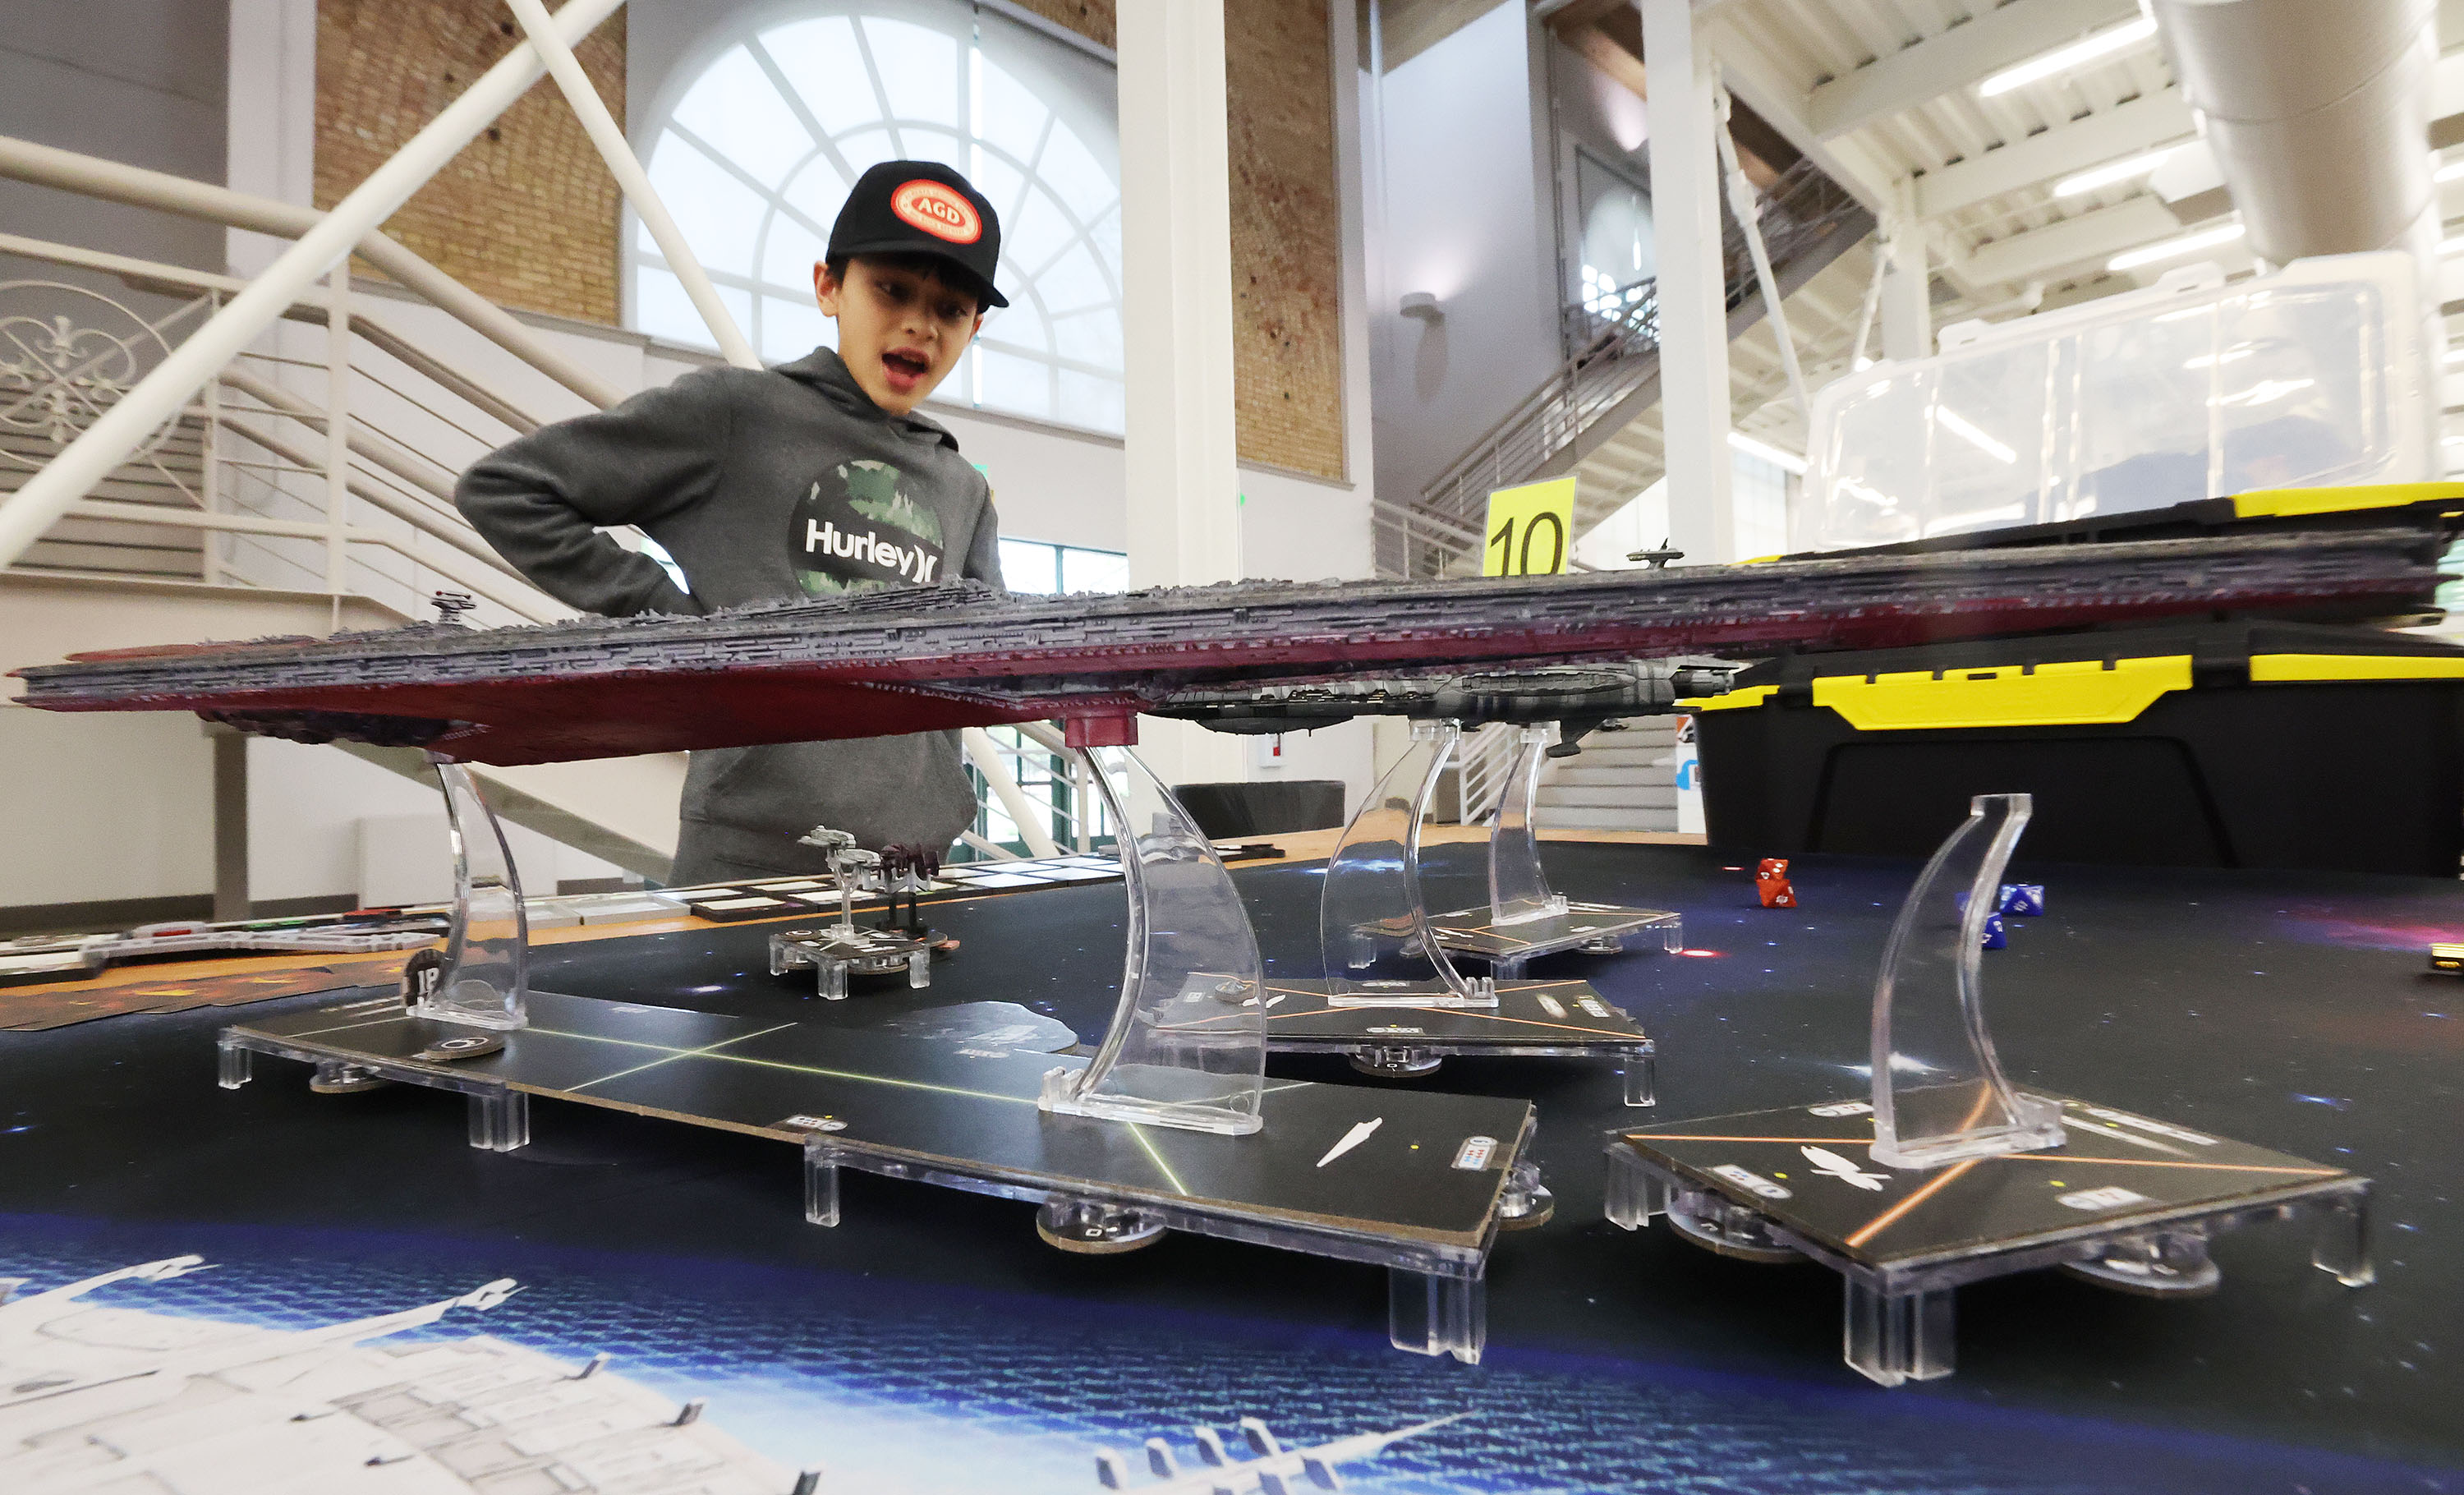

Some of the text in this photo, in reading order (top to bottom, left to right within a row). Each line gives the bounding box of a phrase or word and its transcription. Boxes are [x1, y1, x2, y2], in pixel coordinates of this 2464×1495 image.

[918, 197, 960, 224] AGD
[806, 518, 914, 576] Hurley
[1490, 511, 1563, 577] 10
